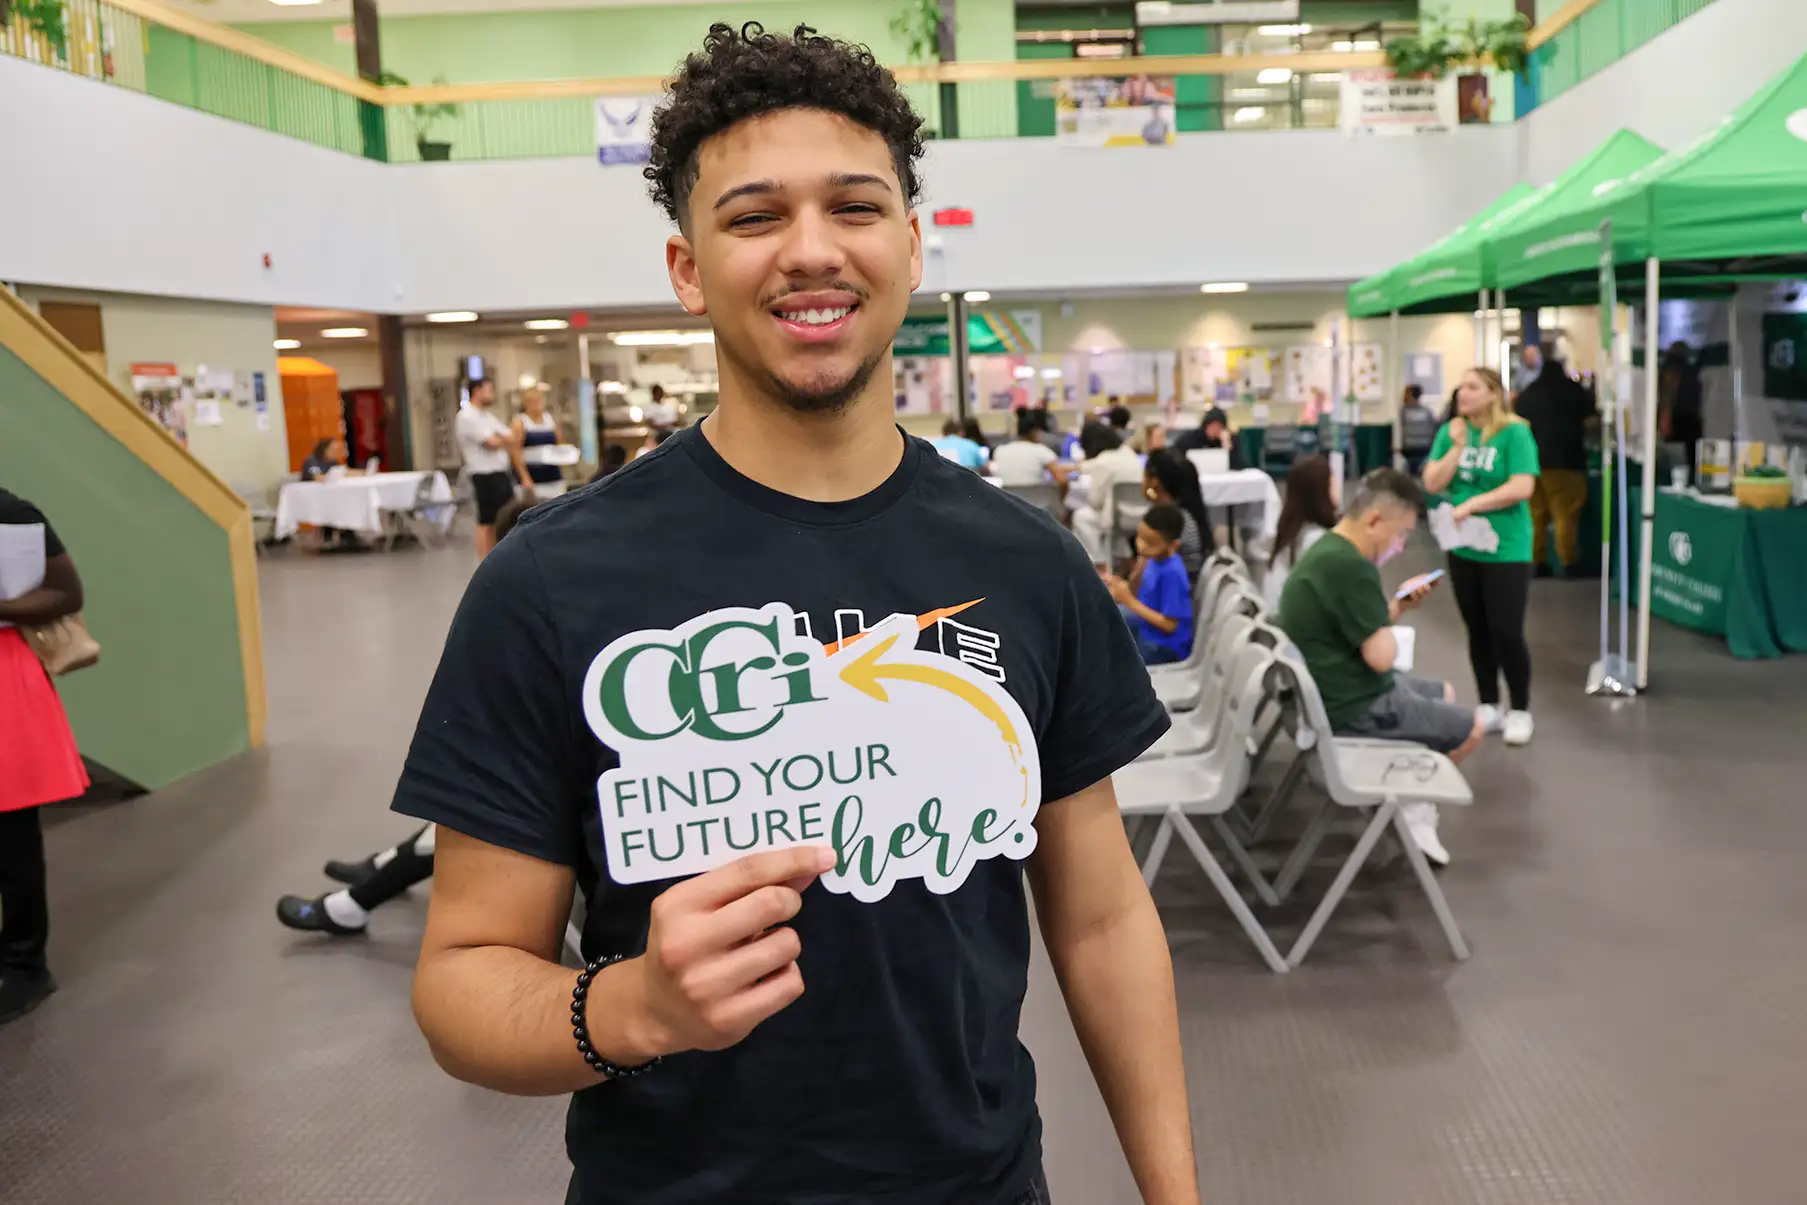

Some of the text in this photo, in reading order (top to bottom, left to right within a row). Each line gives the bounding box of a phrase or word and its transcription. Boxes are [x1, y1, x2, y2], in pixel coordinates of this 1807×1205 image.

[613, 743, 897, 818] FIND YOUR
[620, 802, 825, 868] FUTURE
